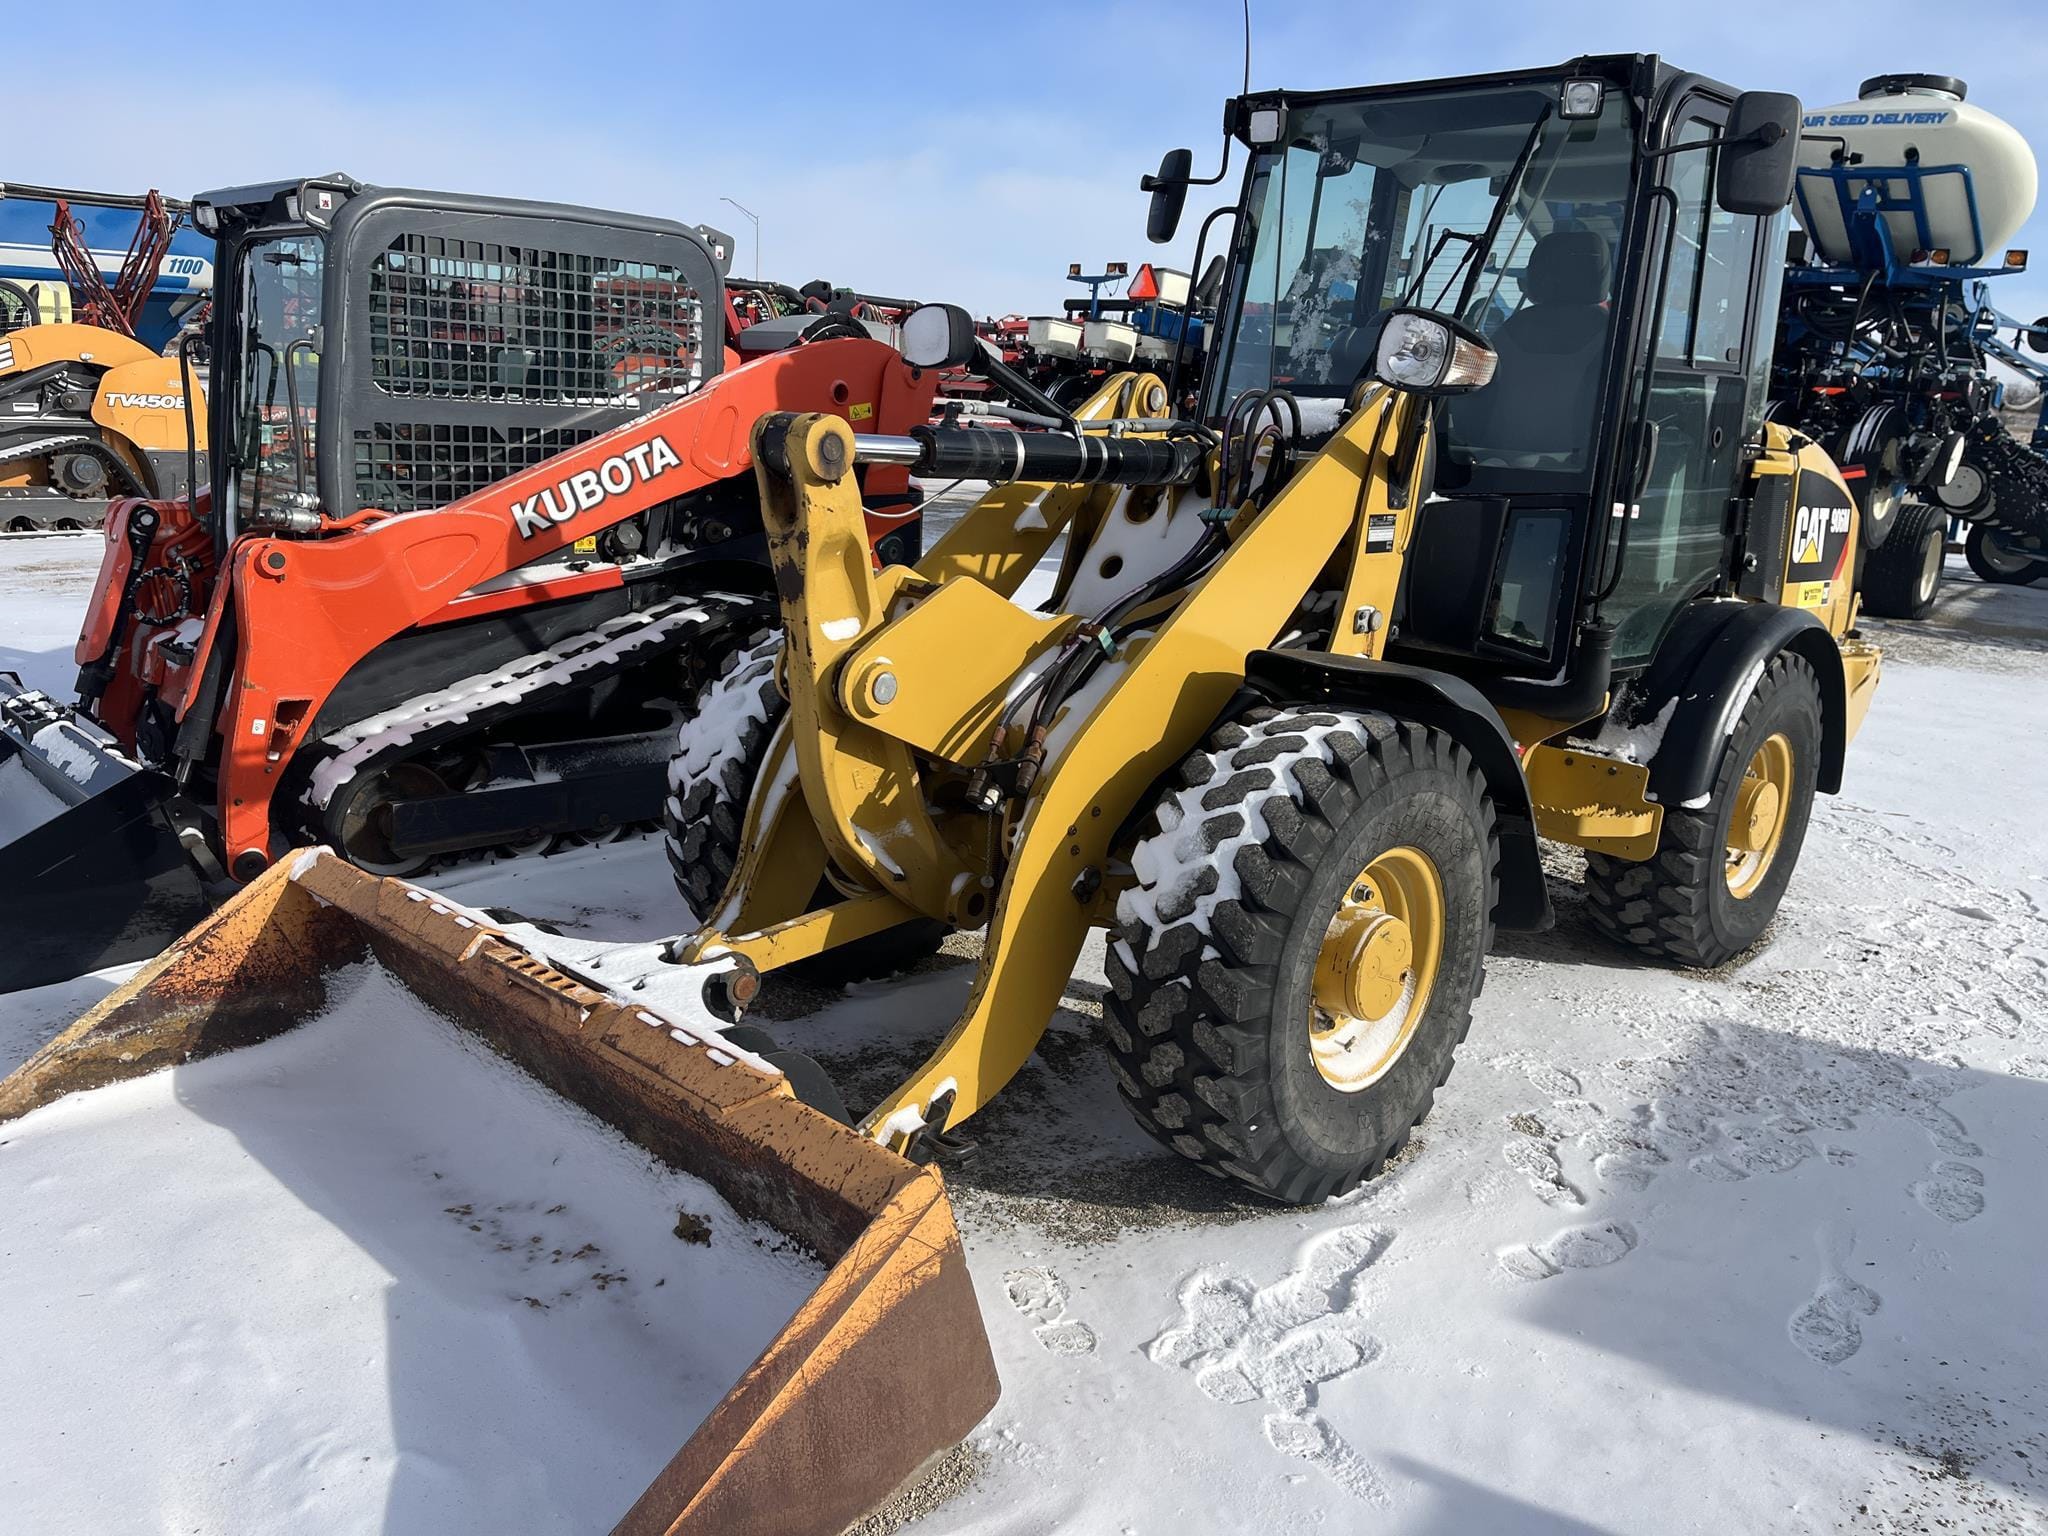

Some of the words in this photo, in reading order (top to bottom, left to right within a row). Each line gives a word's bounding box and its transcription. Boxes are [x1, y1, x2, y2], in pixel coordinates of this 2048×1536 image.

[1803, 115, 1826, 127] AIR
[1829, 114, 1869, 126] SEED
[1872, 112, 1949, 125] DELIVERY
[169, 258, 204, 275] 1100
[510, 436, 682, 539] KUBOTA
[1792, 505, 1830, 564] CAT
